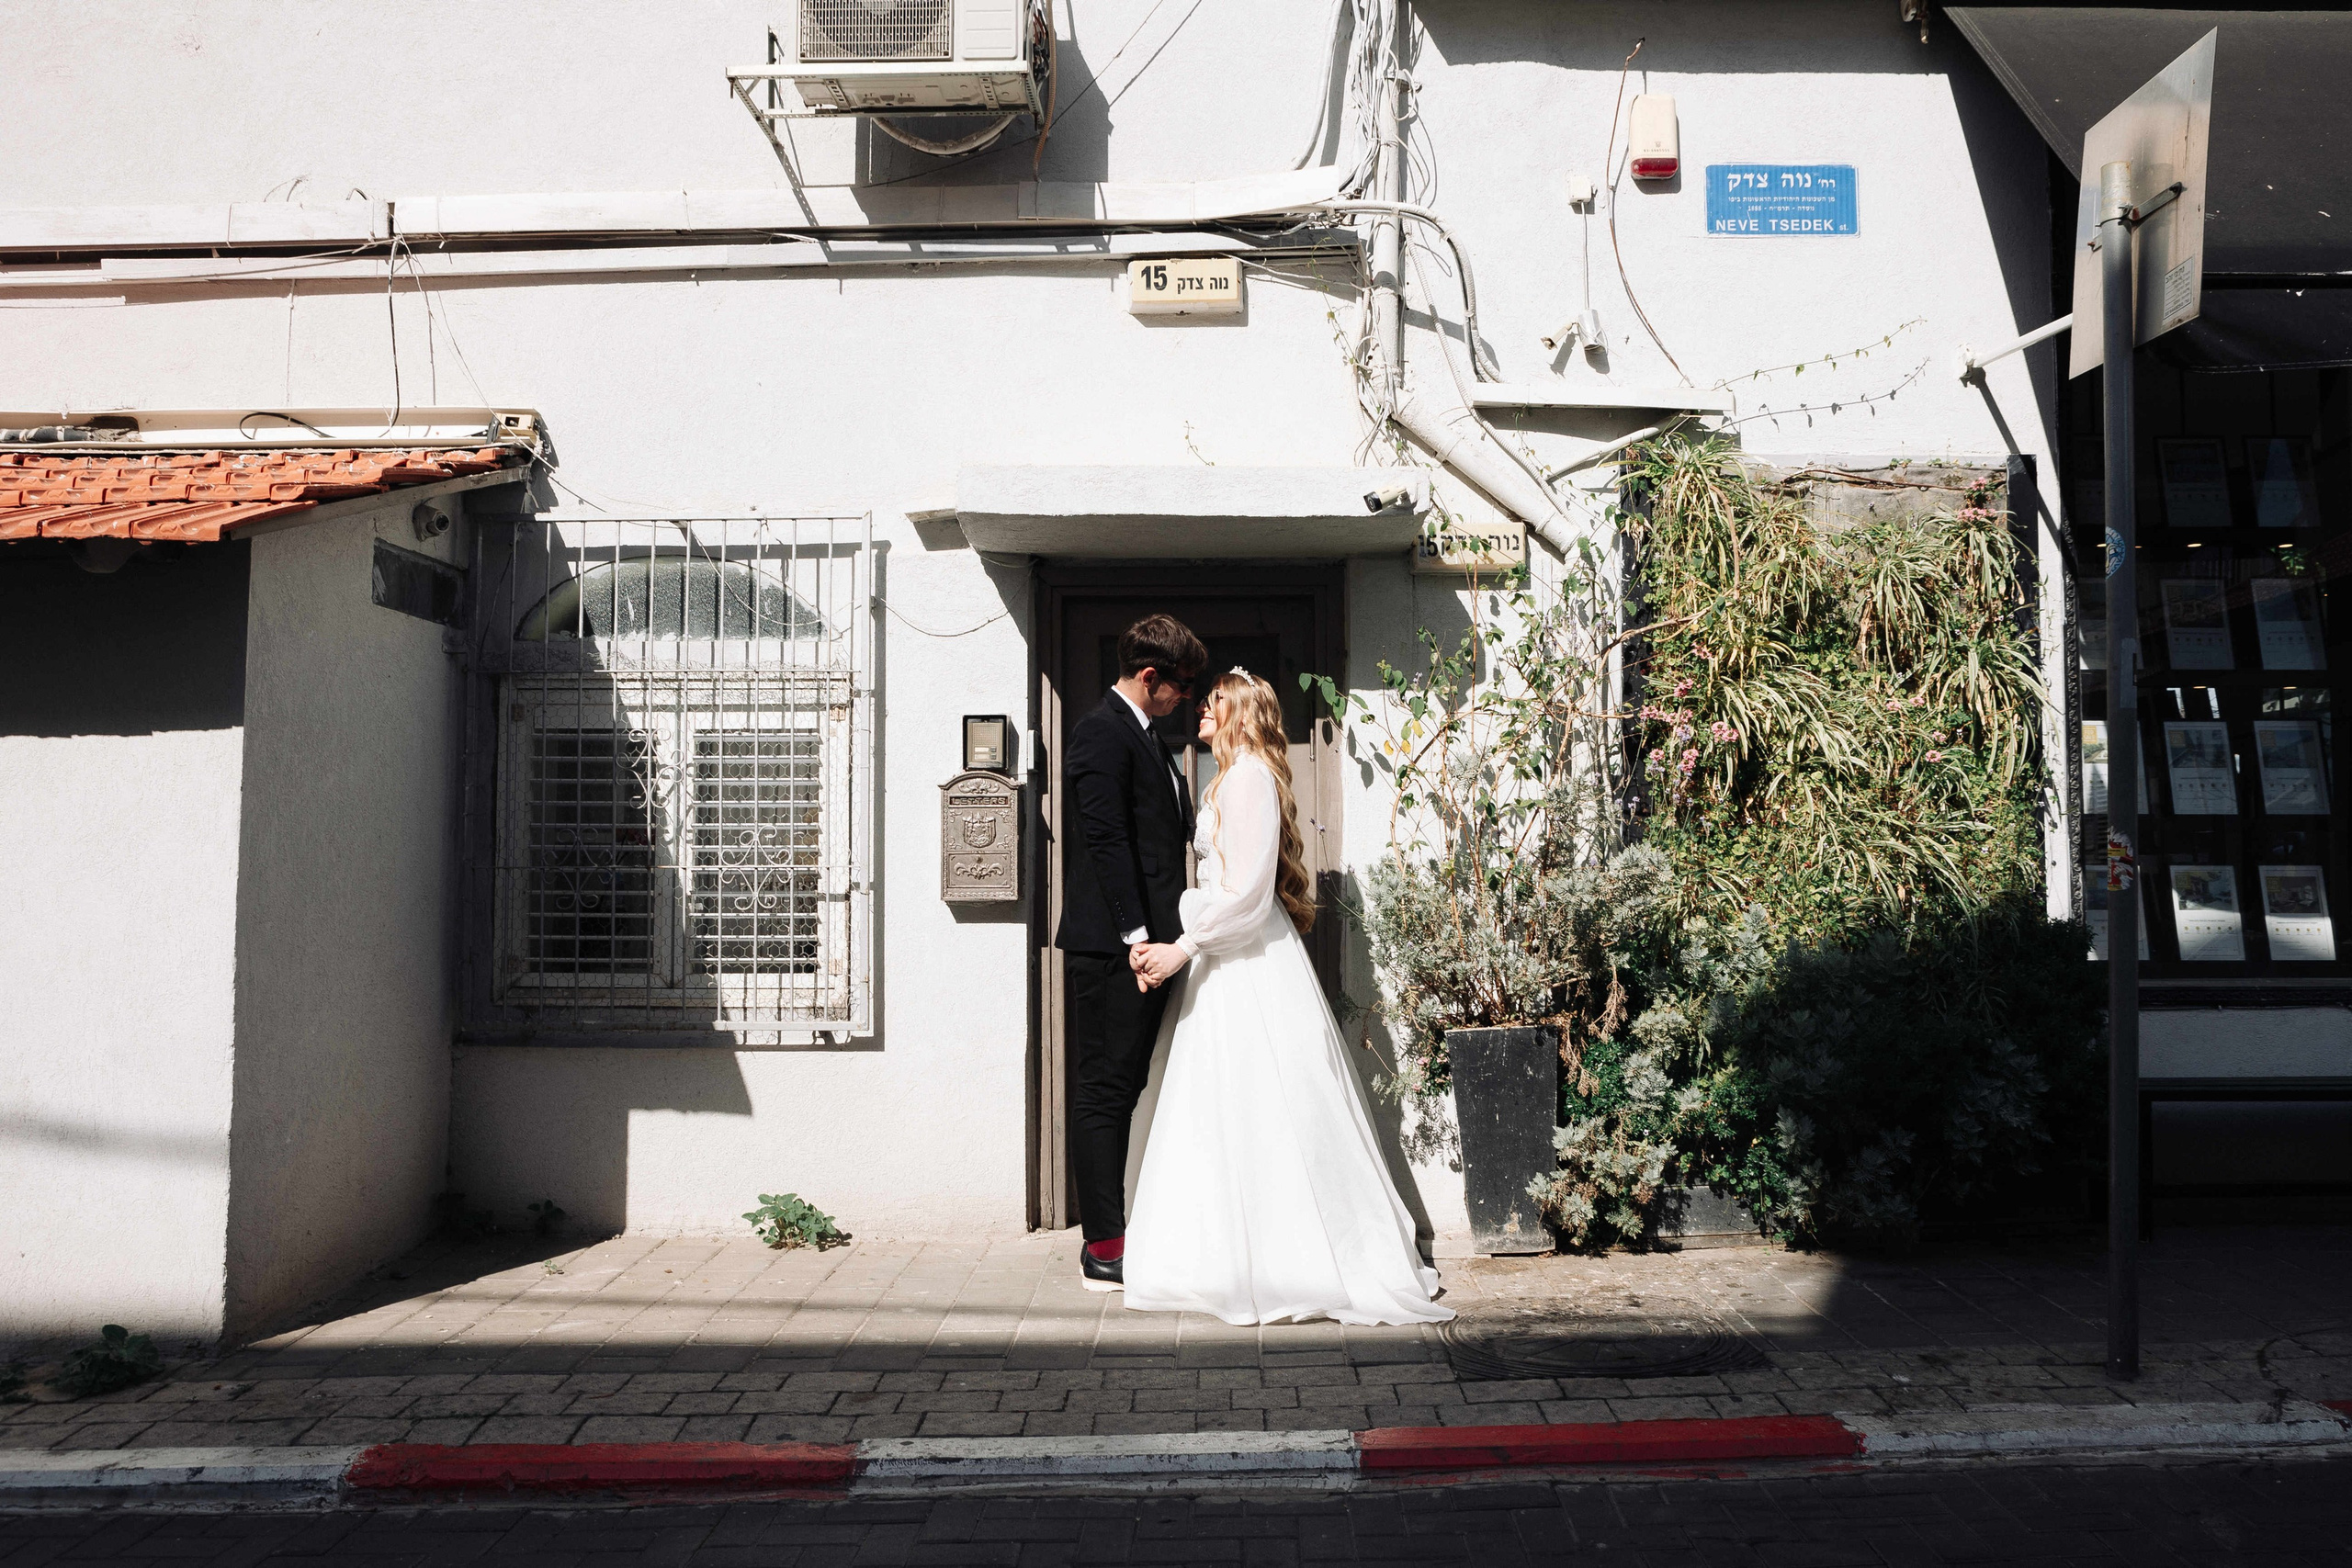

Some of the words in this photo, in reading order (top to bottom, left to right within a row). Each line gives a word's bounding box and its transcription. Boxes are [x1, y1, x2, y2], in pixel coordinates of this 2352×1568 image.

[1726, 172, 1769, 193] צדק
[1781, 172, 1812, 188] נוה
[1715, 220, 1759, 231] NEVE
[1769, 220, 1834, 231] TSEDEK
[1140, 265, 1168, 290] 15
[1177, 276, 1204, 294] צדק
[1209, 276, 1229, 289] נוה
[951, 796, 1006, 805] LETTERS
